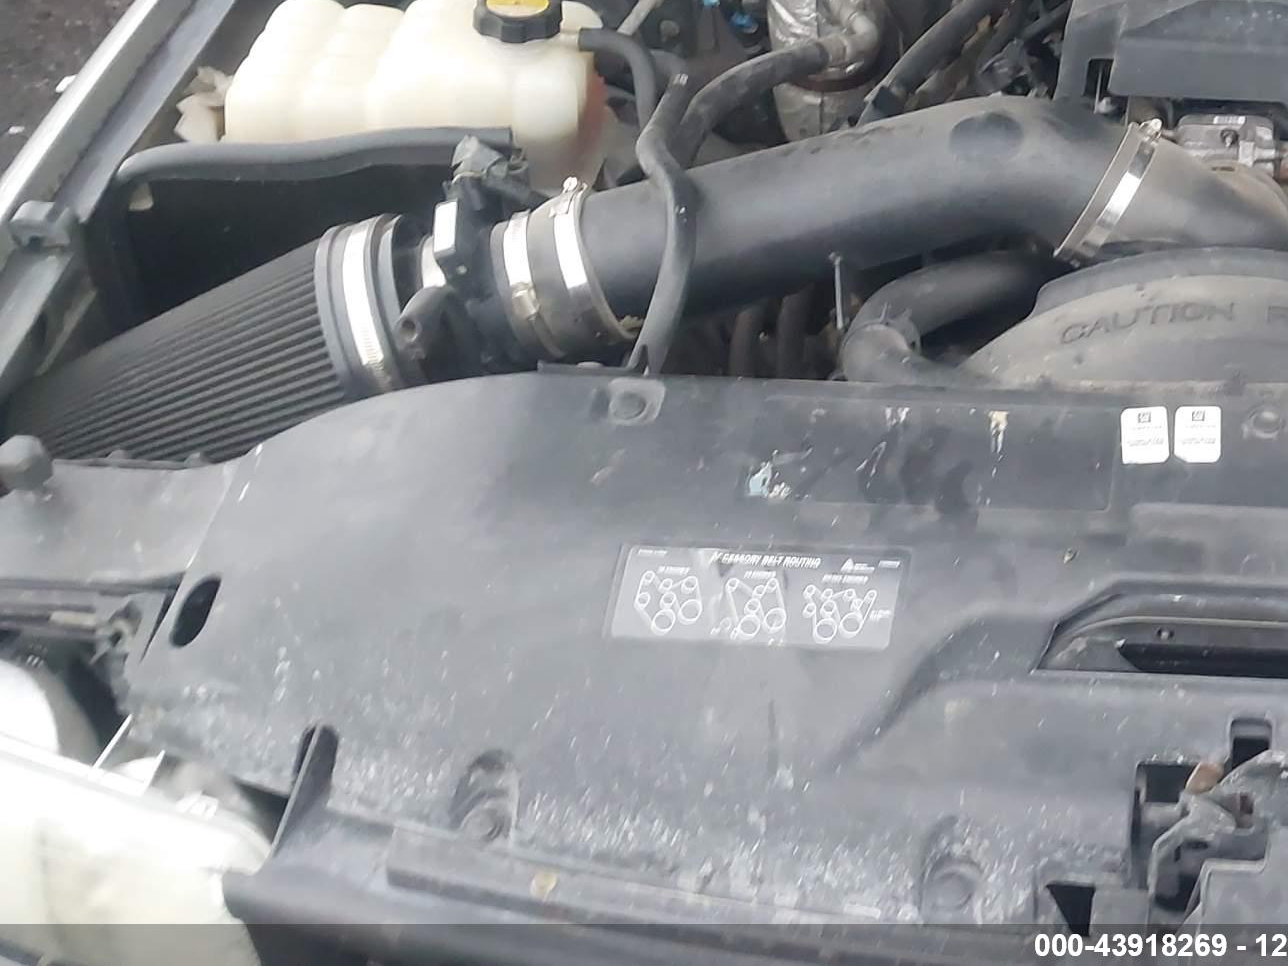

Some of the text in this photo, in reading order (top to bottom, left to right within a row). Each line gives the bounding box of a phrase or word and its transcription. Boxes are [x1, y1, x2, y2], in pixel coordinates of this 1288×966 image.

[1058, 301, 1236, 345] CAUTION
[761, 554, 786, 567] BELT
[782, 555, 822, 570] ROUTING
